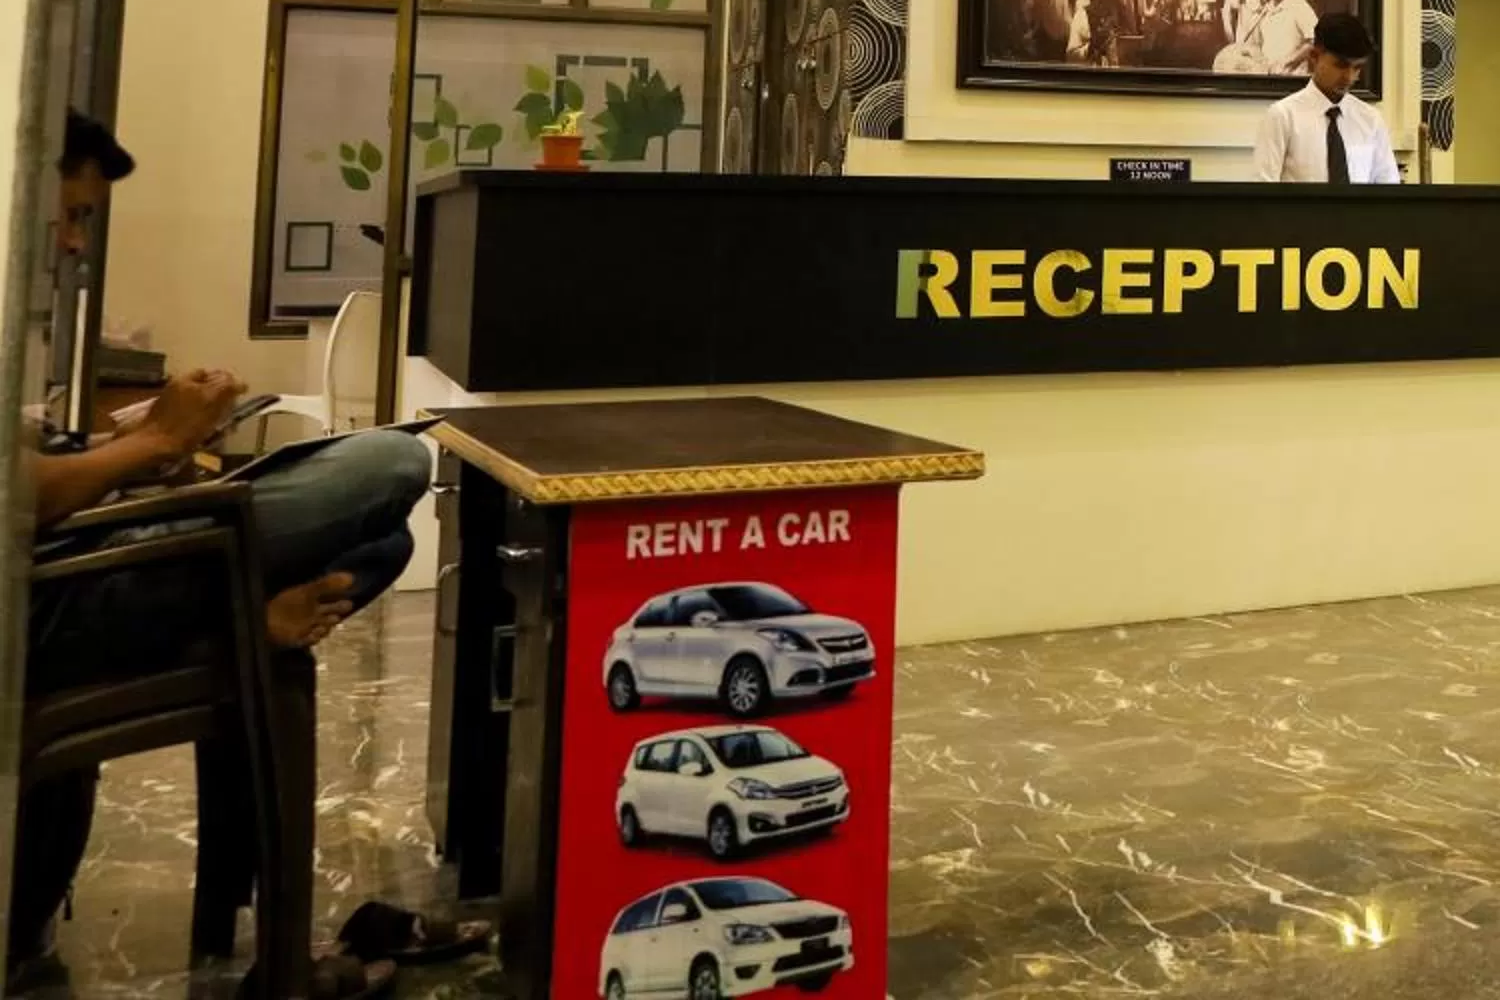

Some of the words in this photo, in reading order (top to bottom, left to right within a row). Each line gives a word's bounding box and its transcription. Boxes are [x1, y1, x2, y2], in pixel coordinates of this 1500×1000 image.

[1117, 161, 1148, 171] CHECK
[1149, 161, 1160, 171] IN
[1162, 161, 1185, 171] TIME
[1130, 171, 1141, 180] 12
[1143, 171, 1172, 180] NOON
[895, 246, 1421, 319] RECEPTION
[626, 518, 729, 560] RENT
[740, 515, 766, 550] A
[777, 509, 850, 547] CAR
